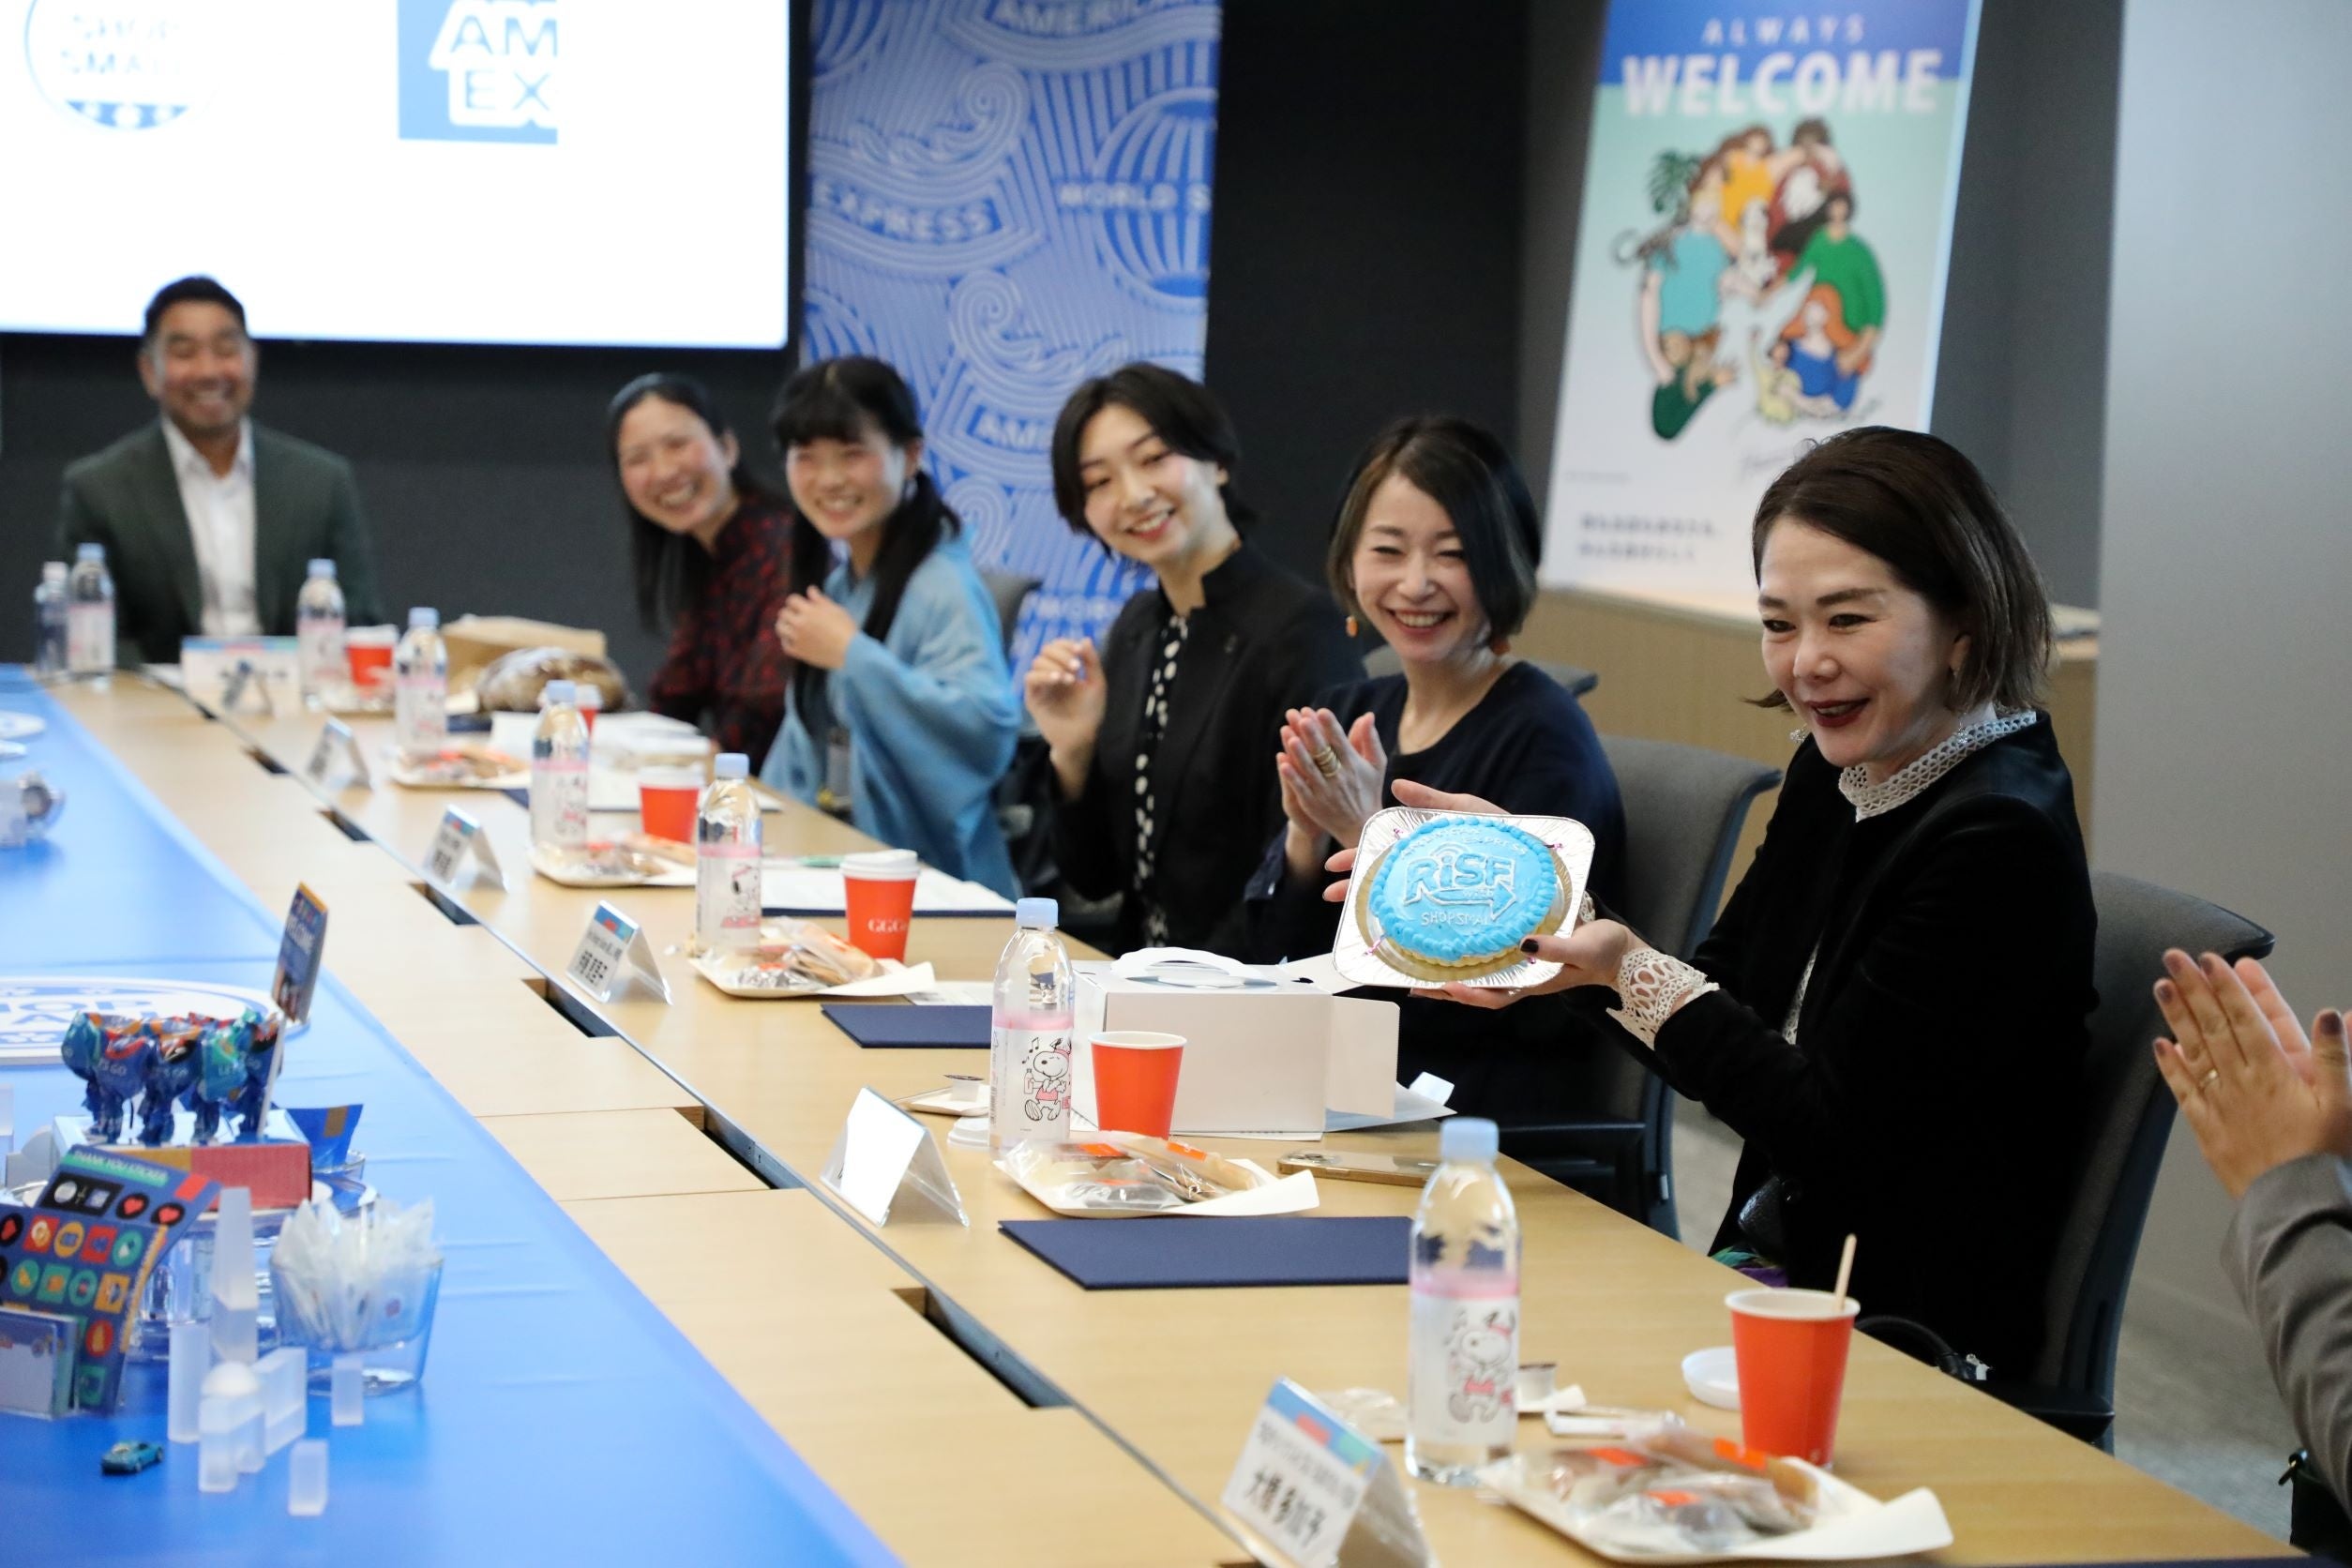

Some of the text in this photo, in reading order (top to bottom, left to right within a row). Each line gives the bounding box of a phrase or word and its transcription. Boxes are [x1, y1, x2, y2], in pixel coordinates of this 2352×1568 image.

[450, 15, 560, 56] AM
[1701, 14, 1865, 45] ALWAYS
[465, 68, 552, 111] EX
[1621, 48, 1943, 115] WELCOME
[812, 178, 990, 238] EXPRESS
[1421, 911, 1455, 927] SHOP
